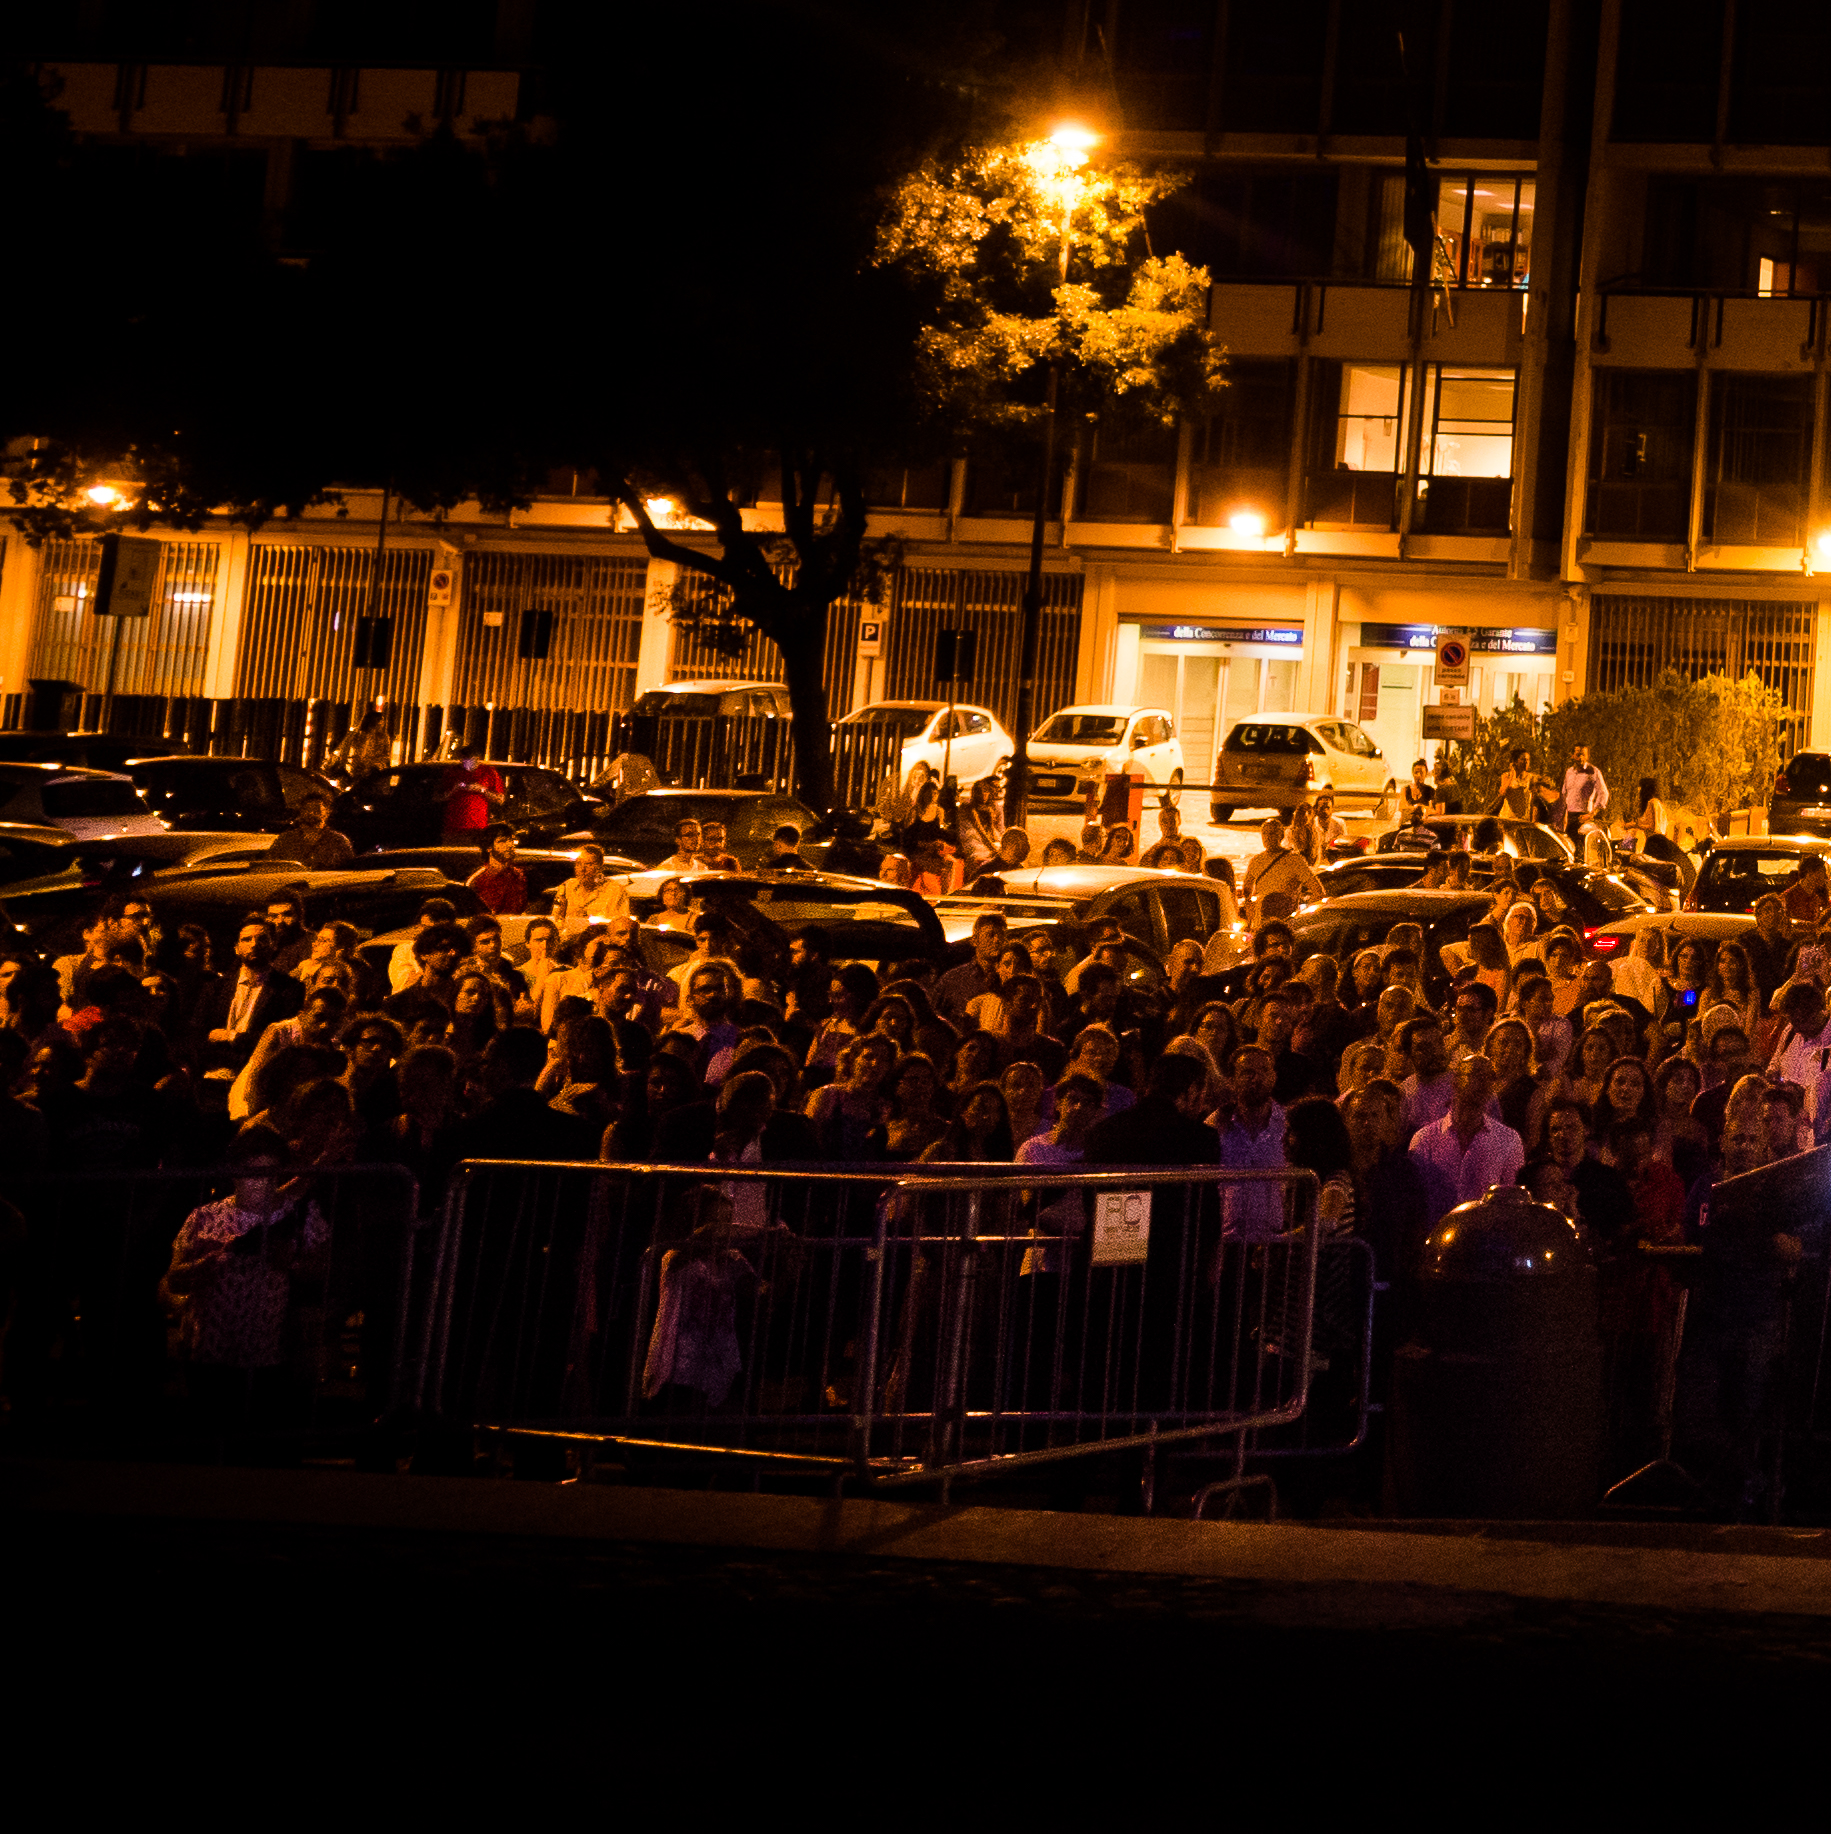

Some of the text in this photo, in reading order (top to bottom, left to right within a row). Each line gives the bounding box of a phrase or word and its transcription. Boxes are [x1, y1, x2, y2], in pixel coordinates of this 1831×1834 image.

[865, 625, 876, 639] P
[1173, 626, 1194, 638] della
[1252, 629, 1264, 641] del
[1265, 630, 1297, 642] Mercato
[1410, 635, 1430, 648] della
[1488, 638, 1500, 650] del
[1502, 640, 1536, 652] Mercato
